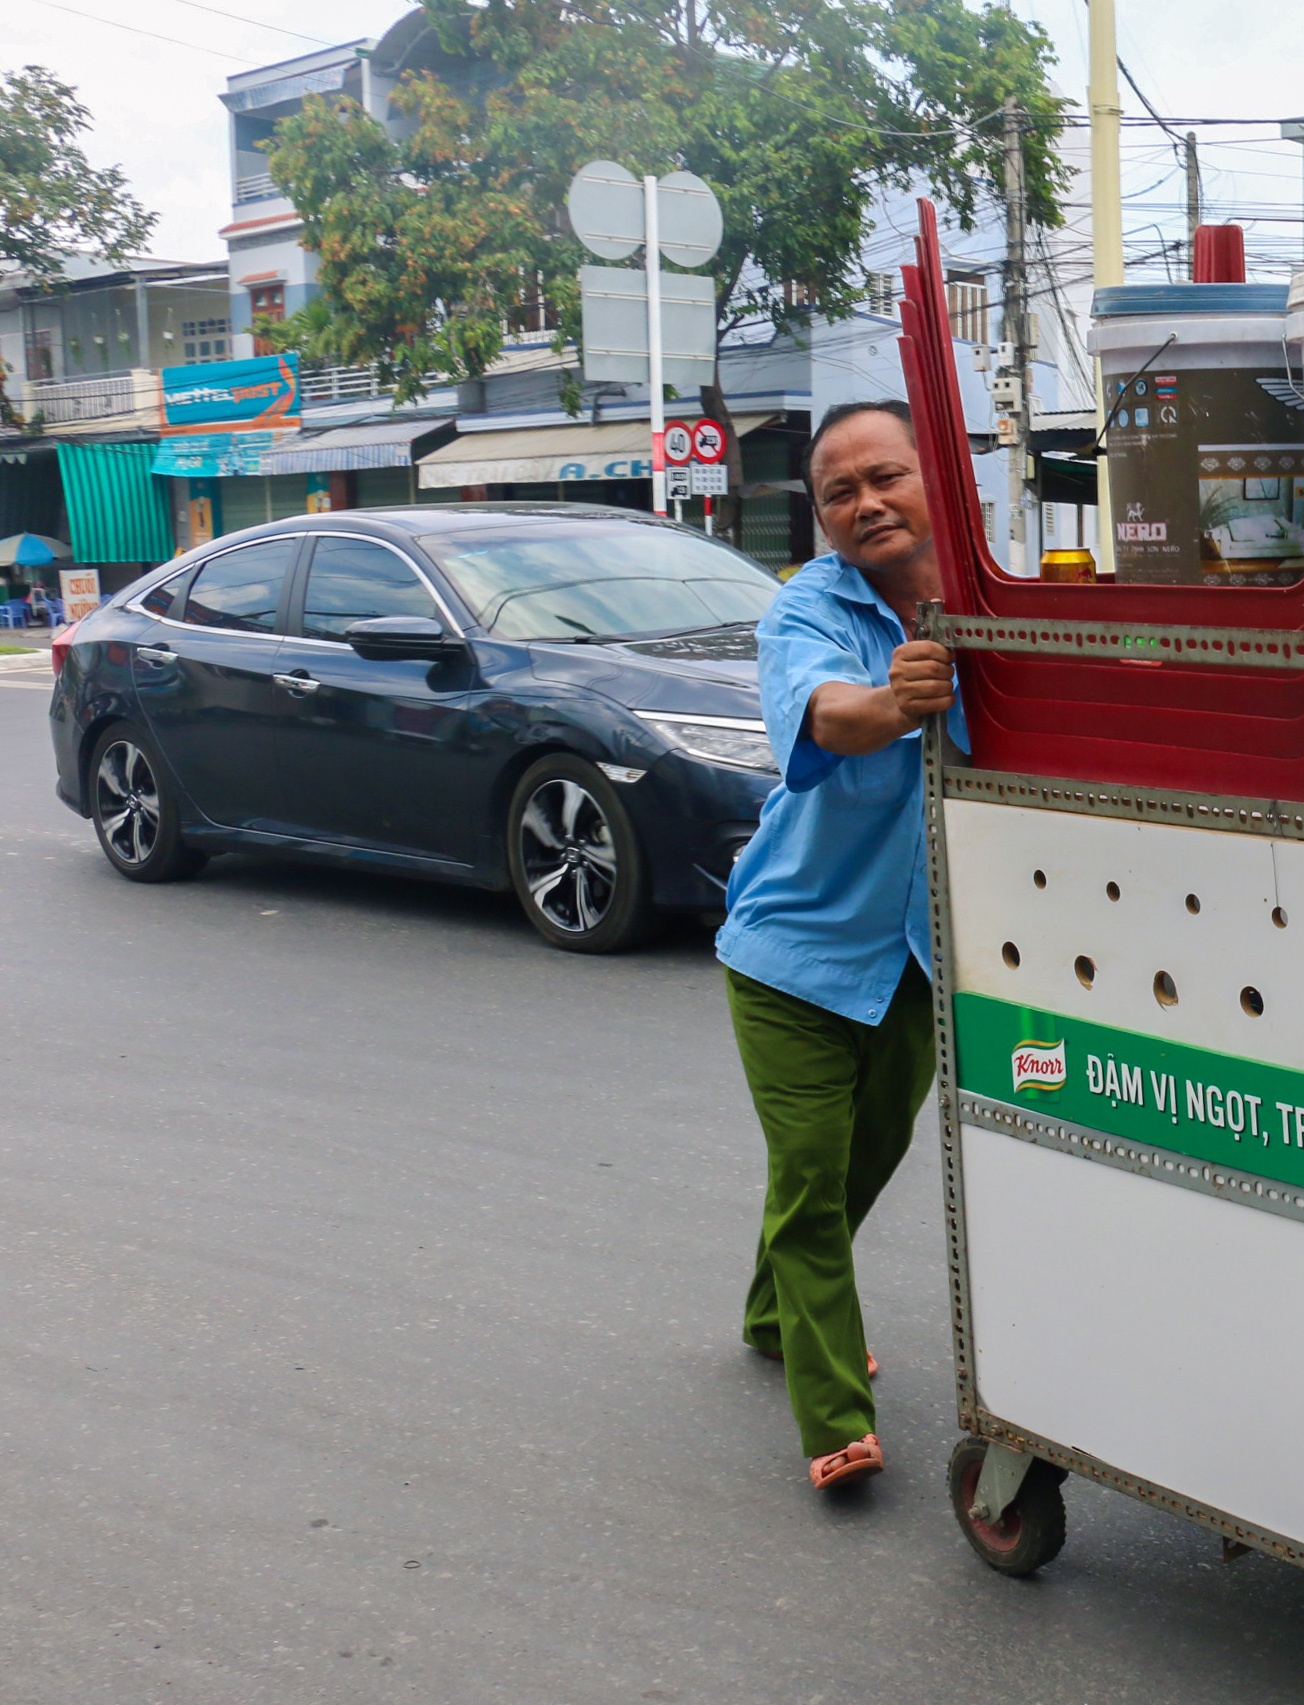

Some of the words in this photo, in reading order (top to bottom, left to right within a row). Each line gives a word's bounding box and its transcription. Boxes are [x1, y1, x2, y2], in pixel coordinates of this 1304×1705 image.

[559, 460, 653, 479] A.CH
[1117, 523, 1167, 541] NERO
[1014, 1053, 1063, 1077] Knorr
[1086, 1053, 1144, 1110] ĐẬM
[1151, 1070, 1179, 1125] VỊ
[1186, 1081, 1270, 1147] NGỌT,
